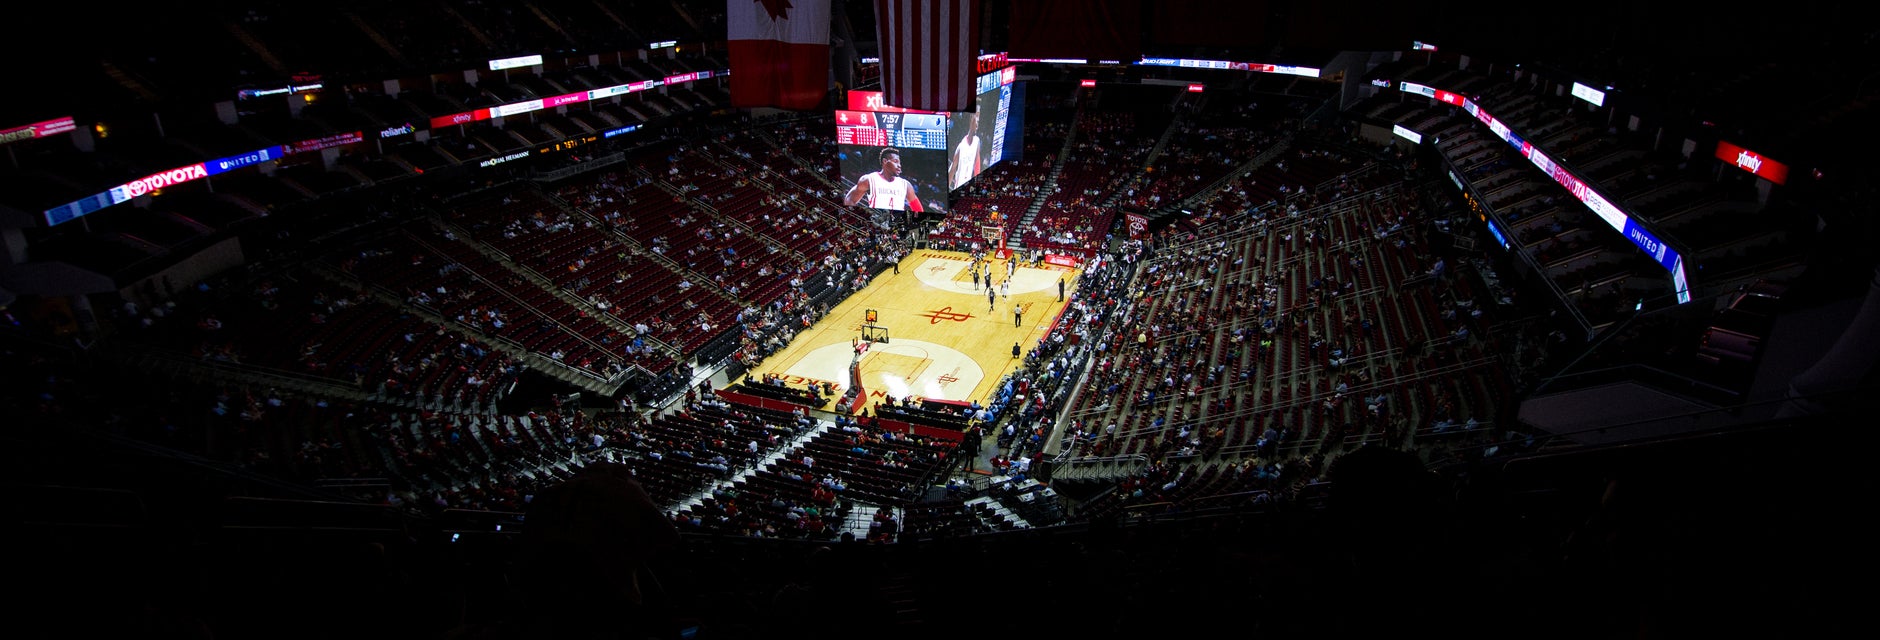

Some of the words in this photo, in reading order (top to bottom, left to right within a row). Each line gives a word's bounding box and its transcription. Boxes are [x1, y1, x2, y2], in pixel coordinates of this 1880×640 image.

[861, 113, 867, 123] 8
[882, 114, 899, 123] 7:57
[381, 126, 407, 138] reliant
[220, 154, 258, 170] UNITED
[1736, 150, 1762, 173] xfinity
[146, 165, 208, 191] TOYOTA
[1560, 171, 1586, 201] TOYOTA
[1127, 214, 1148, 225] TOYOTA
[1631, 228, 1657, 253] UNITED
